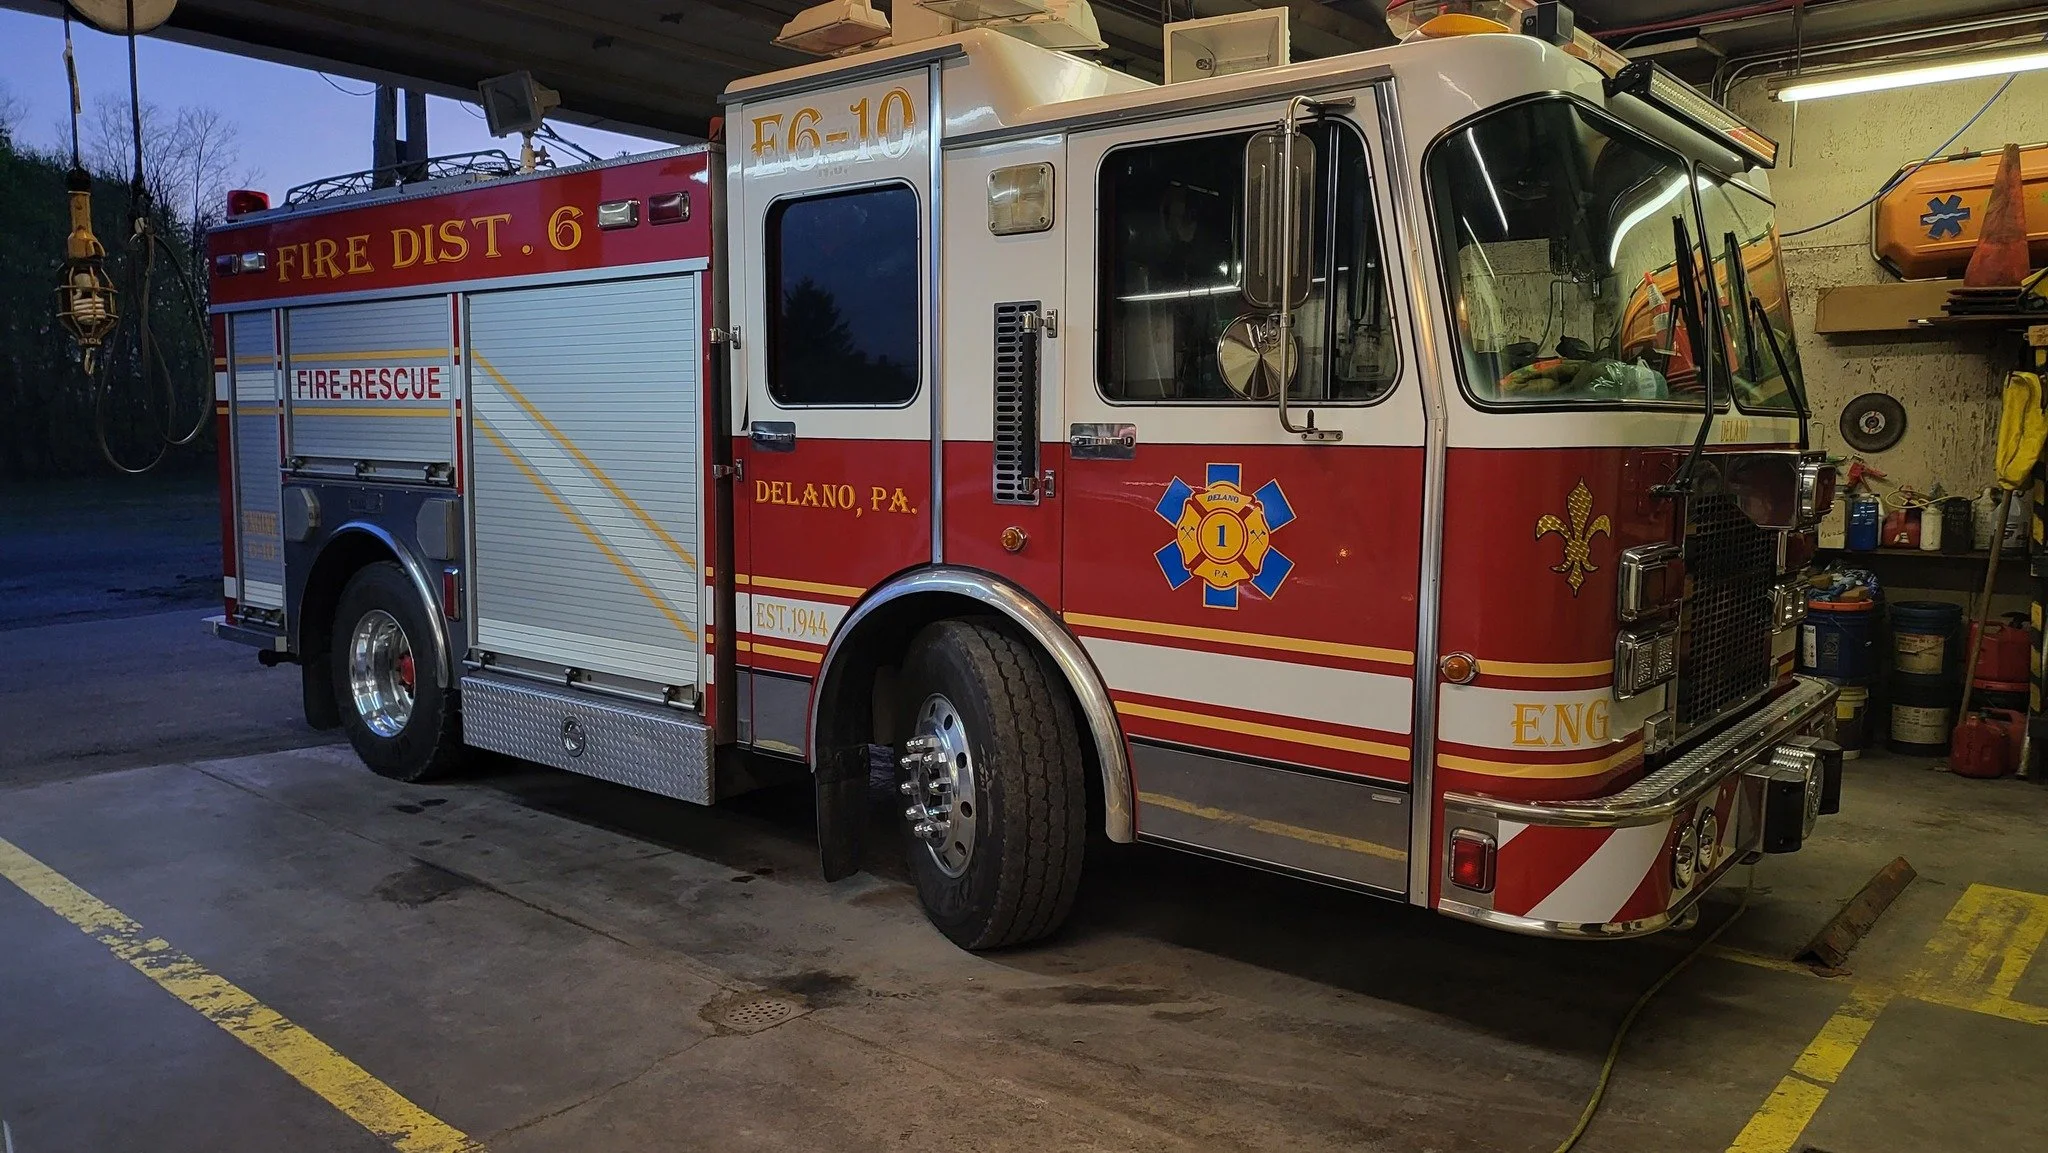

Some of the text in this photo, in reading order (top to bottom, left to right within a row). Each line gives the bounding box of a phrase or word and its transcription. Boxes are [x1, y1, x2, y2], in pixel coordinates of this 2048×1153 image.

[751, 87, 916, 178] E6-10
[276, 234, 375, 282] FIRE
[548, 205, 584, 251] 6
[297, 367, 441, 400] FIRE-RESCUE
[1720, 419, 1750, 443] DELANO
[756, 480, 917, 518] DELANO, PA.
[1207, 494, 1240, 504] DELANO
[1216, 525, 1228, 547] 1
[1214, 569, 1228, 578] PA
[1510, 698, 1609, 748] ENG
